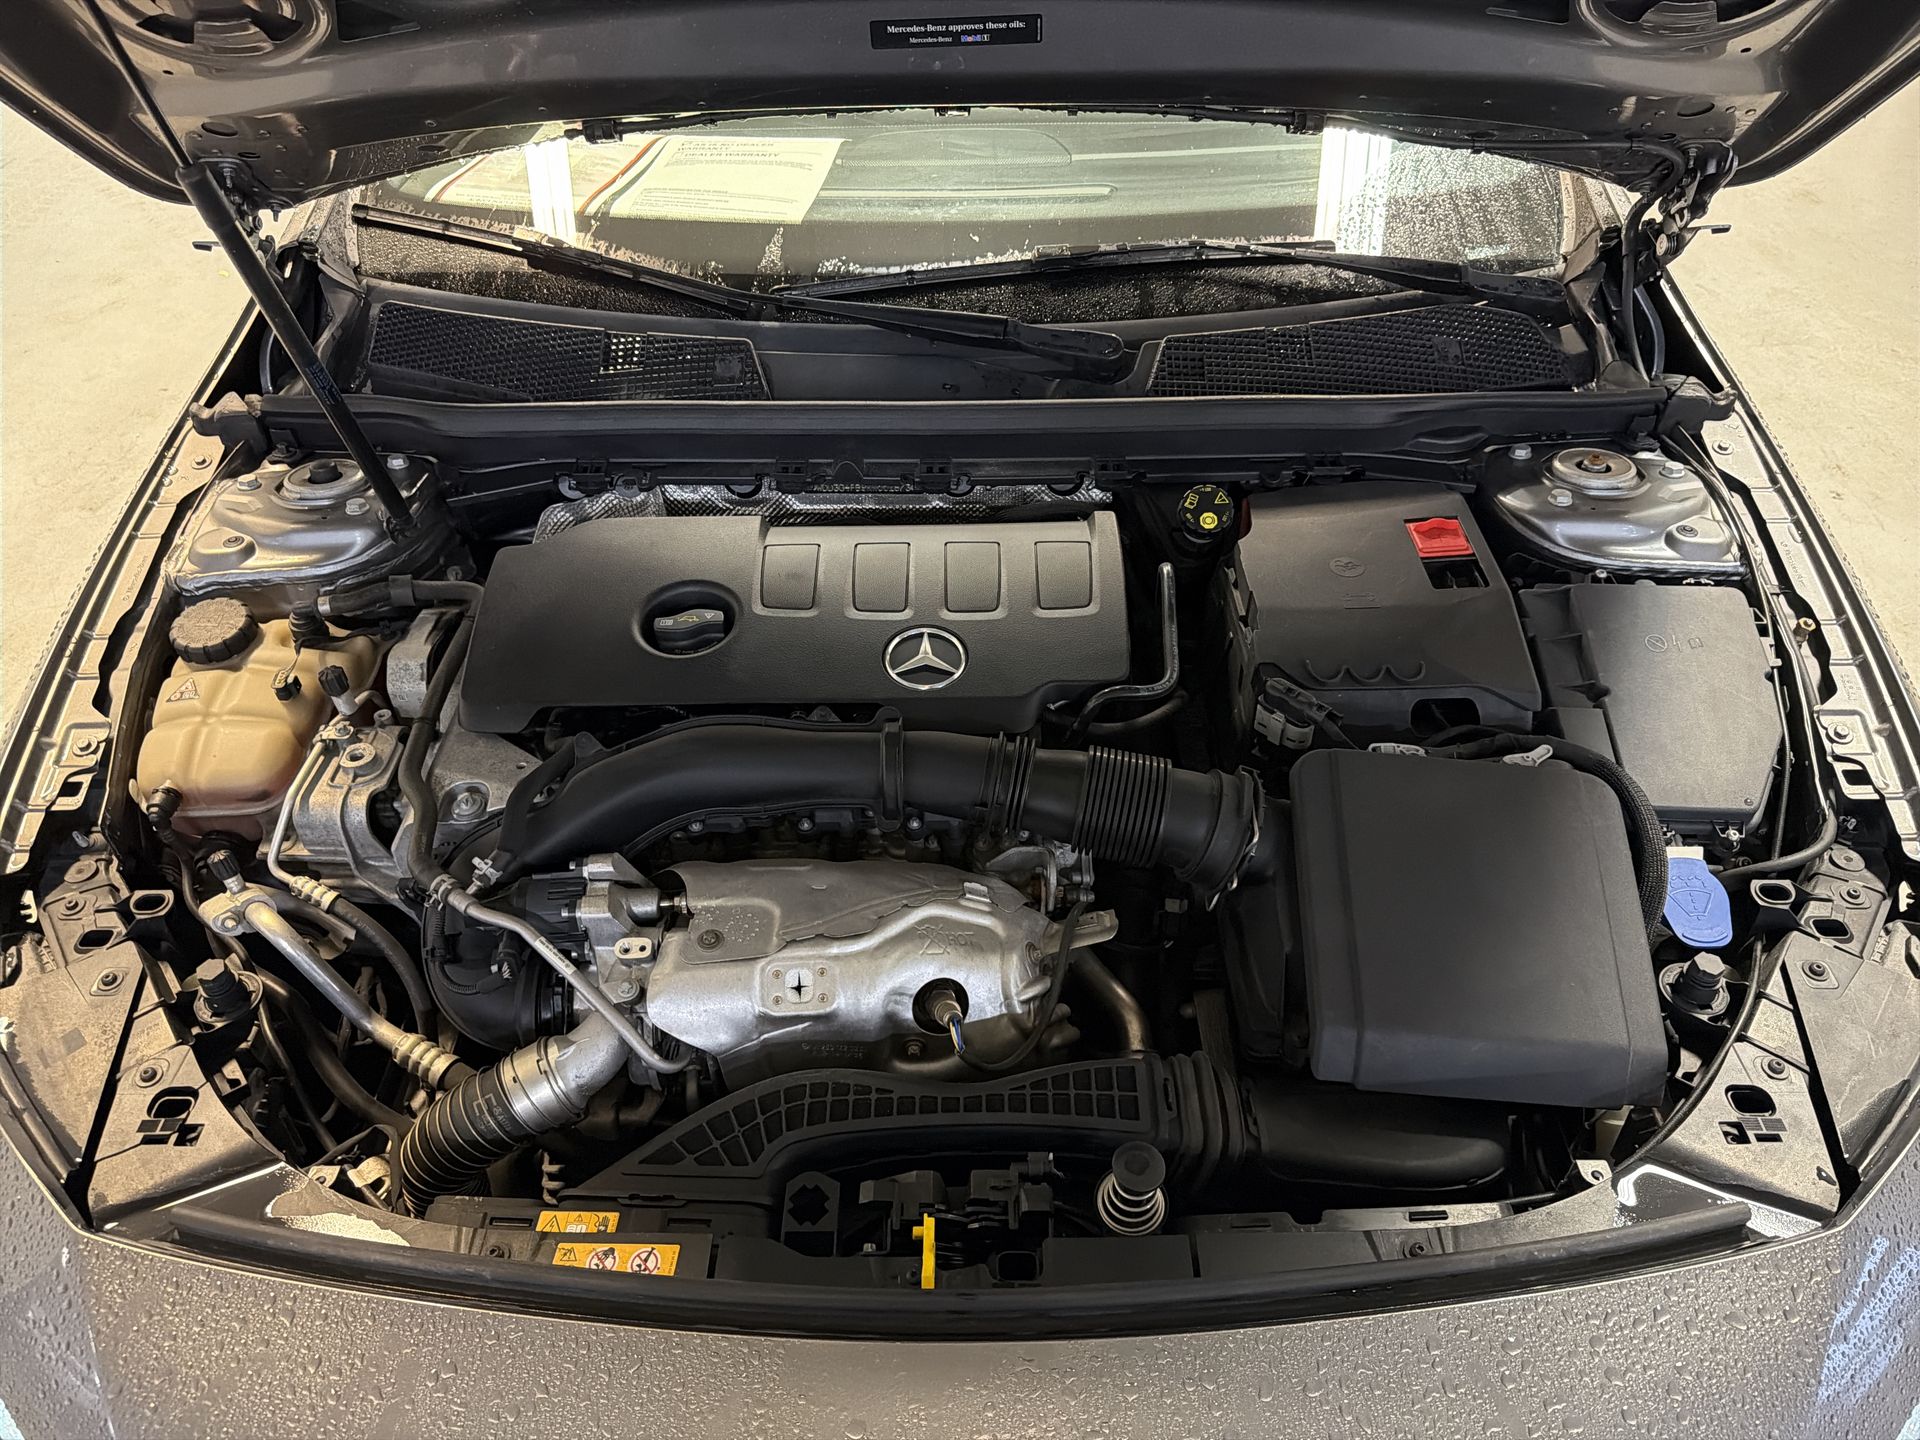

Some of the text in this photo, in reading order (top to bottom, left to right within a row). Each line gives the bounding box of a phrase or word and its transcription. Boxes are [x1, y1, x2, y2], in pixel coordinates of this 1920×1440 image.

[887, 20, 1026, 33] Mercedes-Benz approves these oils:
[909, 36, 953, 44] Mercedes-Benz
